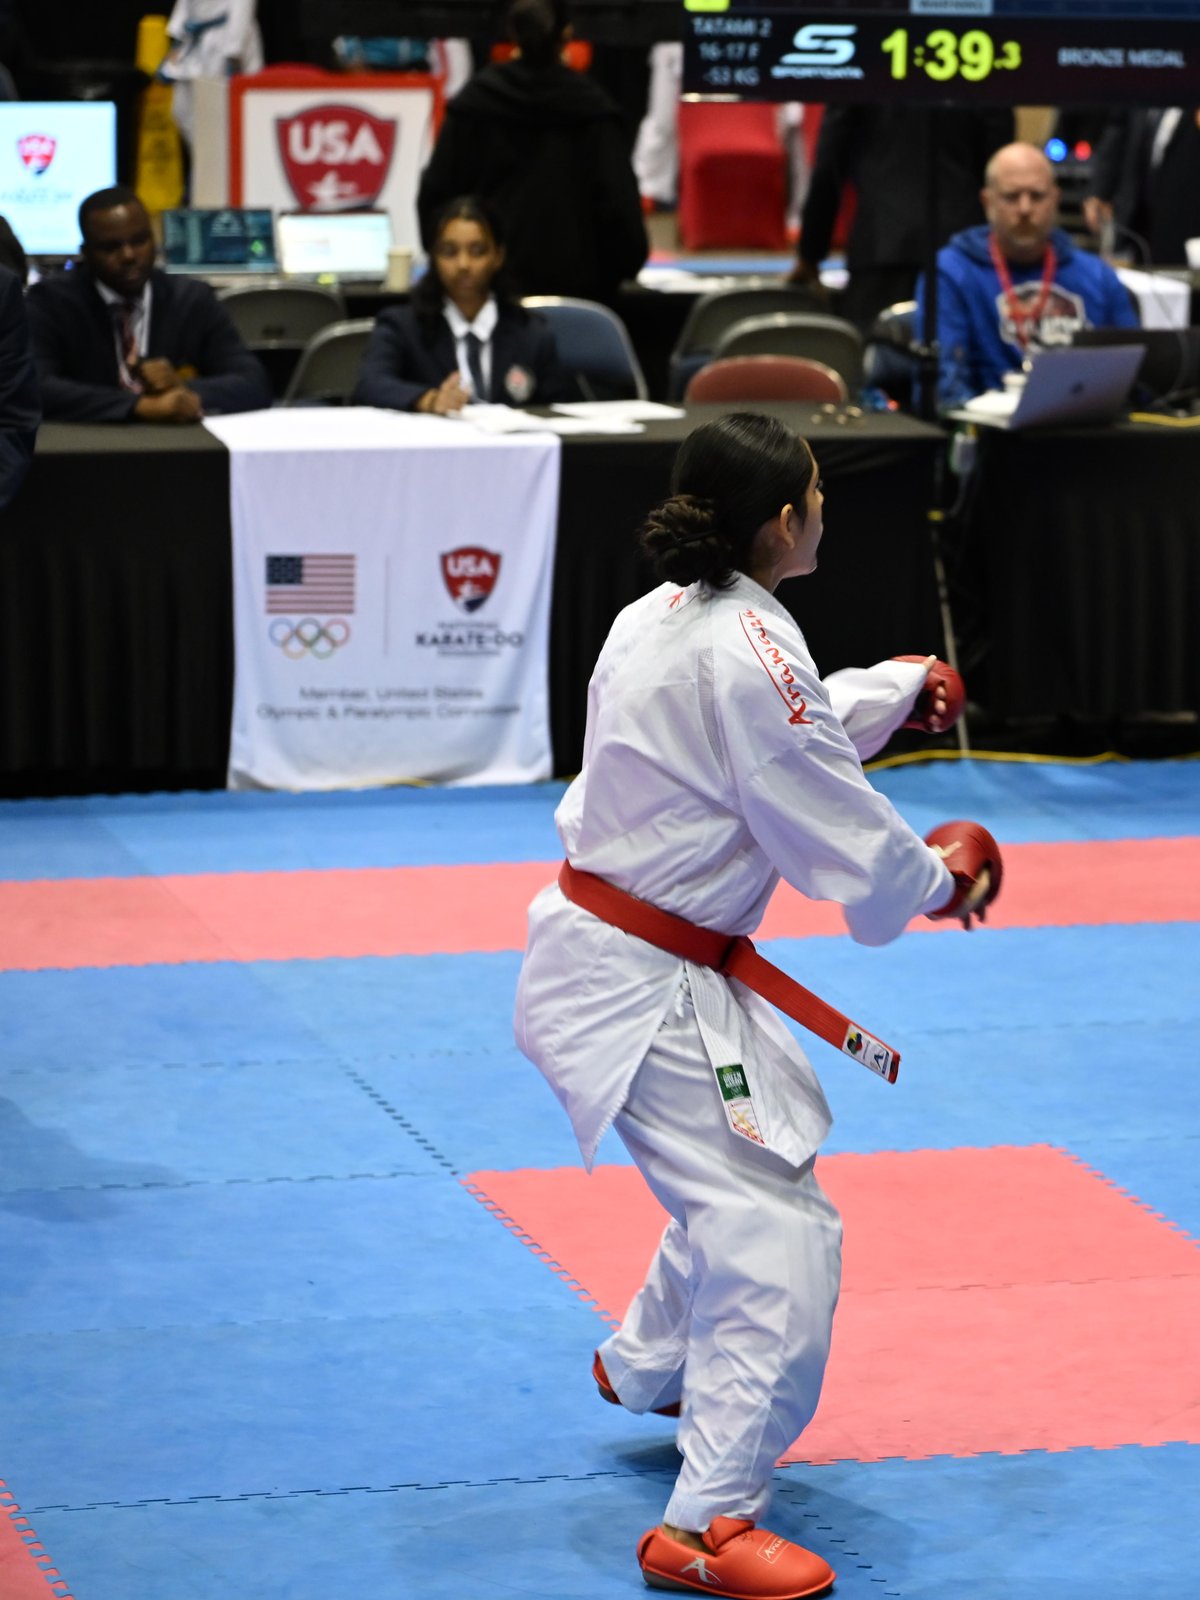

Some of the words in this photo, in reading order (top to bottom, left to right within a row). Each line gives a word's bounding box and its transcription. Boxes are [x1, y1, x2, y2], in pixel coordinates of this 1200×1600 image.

[693, 17, 755, 36] TATAMI
[760, 19, 771, 37] 2
[1057, 48, 1124, 66] BRONZE
[1128, 49, 1185, 67] MEDAL
[288, 121, 384, 165] USA
[447, 556, 493, 577] USA
[416, 630, 523, 647] KARATE-DO
[739, 608, 815, 726] Arawaza
